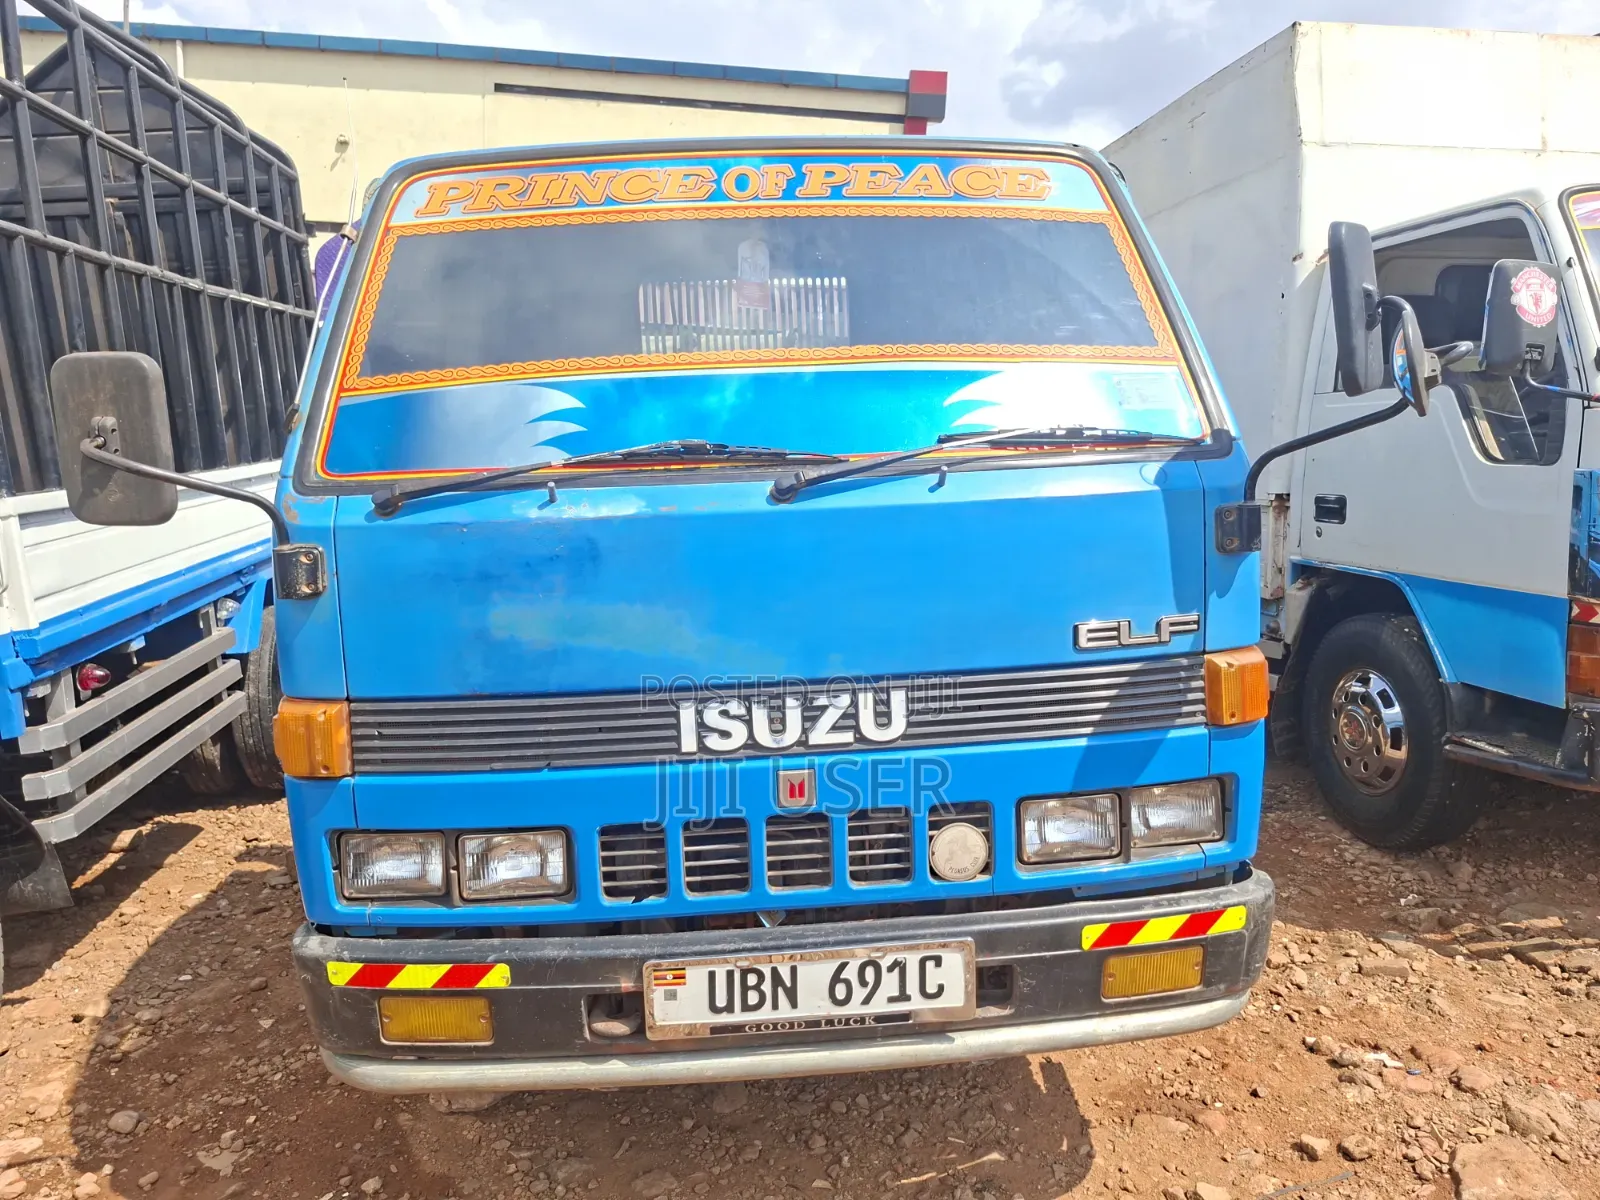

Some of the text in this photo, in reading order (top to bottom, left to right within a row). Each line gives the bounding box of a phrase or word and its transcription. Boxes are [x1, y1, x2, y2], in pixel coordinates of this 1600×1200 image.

[413, 161, 1055, 218] PRINCE OF PEACE
[1516, 271, 1554, 289] MANCHESTER
[1525, 312, 1552, 322] UNITED
[1074, 613, 1200, 650] ELF
[679, 688, 908, 754] ISUZU
[708, 954, 945, 1015] UBN 691C
[744, 1015, 878, 1034] GOOD LUCK
